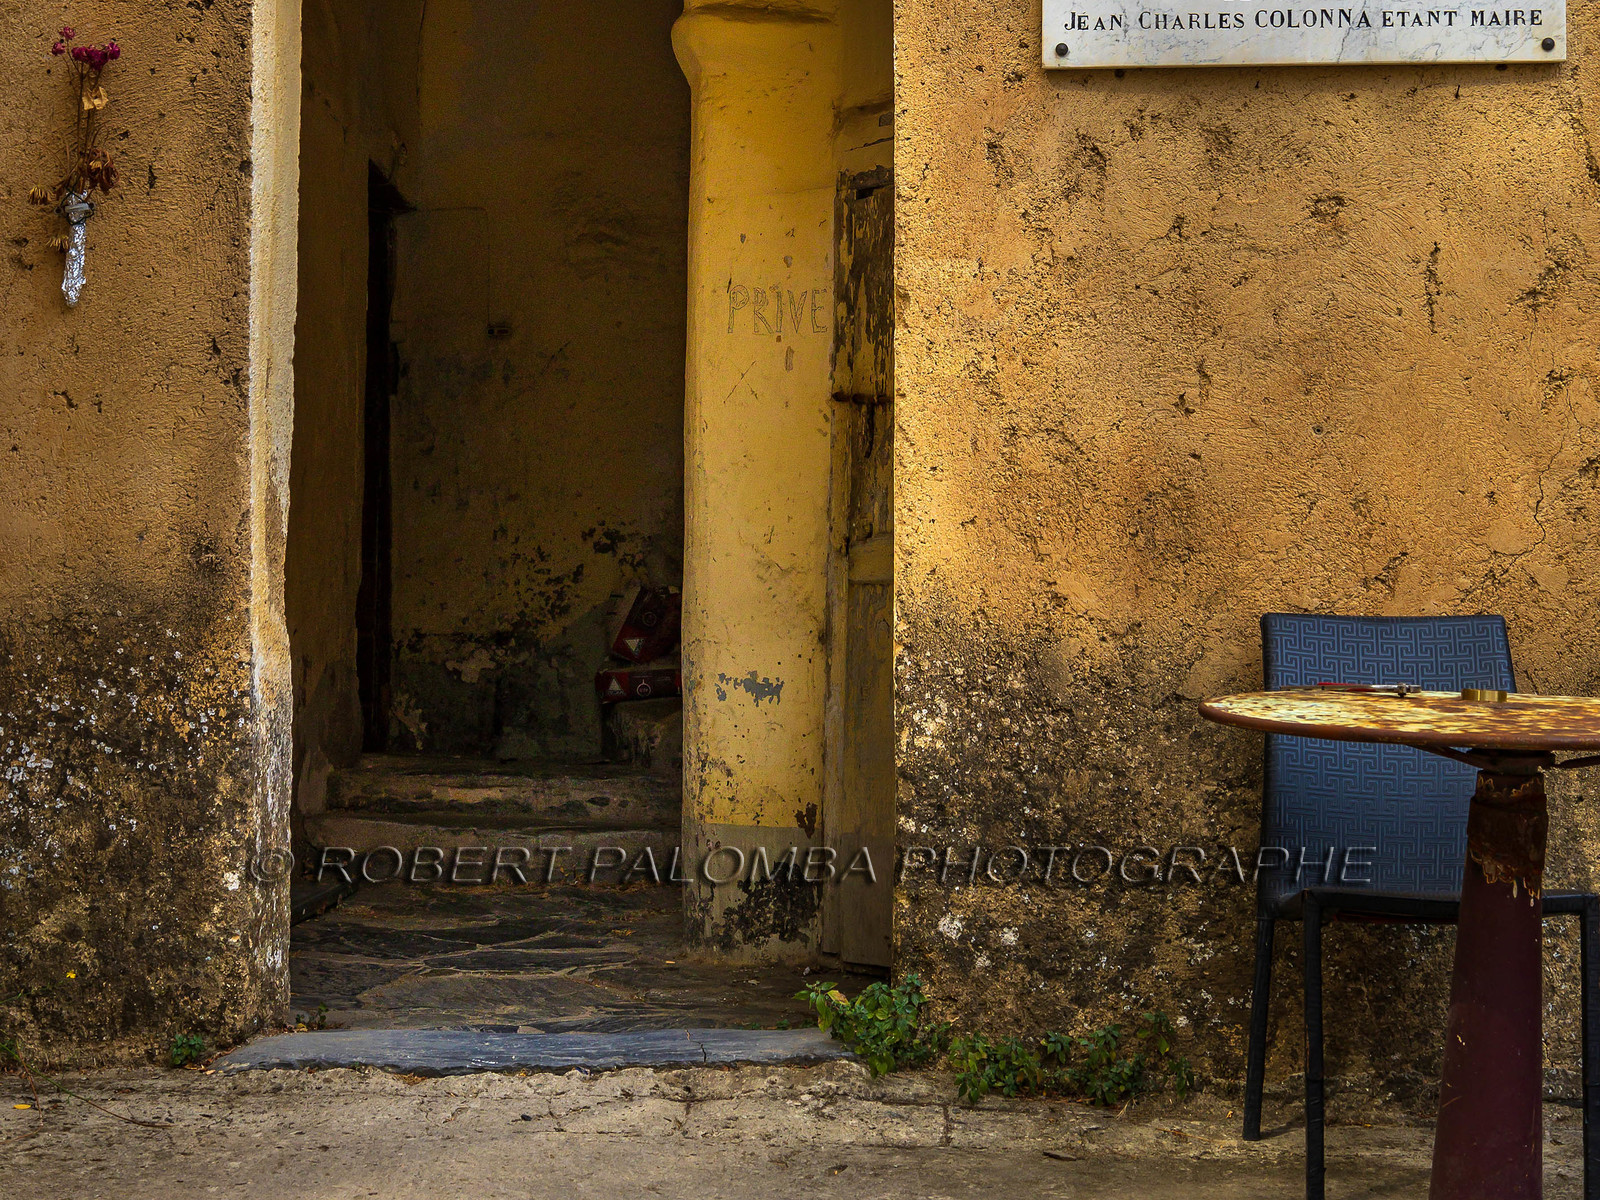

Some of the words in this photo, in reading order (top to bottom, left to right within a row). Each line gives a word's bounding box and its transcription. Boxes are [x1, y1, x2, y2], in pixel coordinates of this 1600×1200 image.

[1064, 11, 1123, 31] JEAN
[1138, 11, 1245, 30] CHARLES
[1254, 8, 1372, 29] COLONNA
[1382, 10, 1458, 28] ETANT
[1470, 9, 1543, 27] MAIRE
